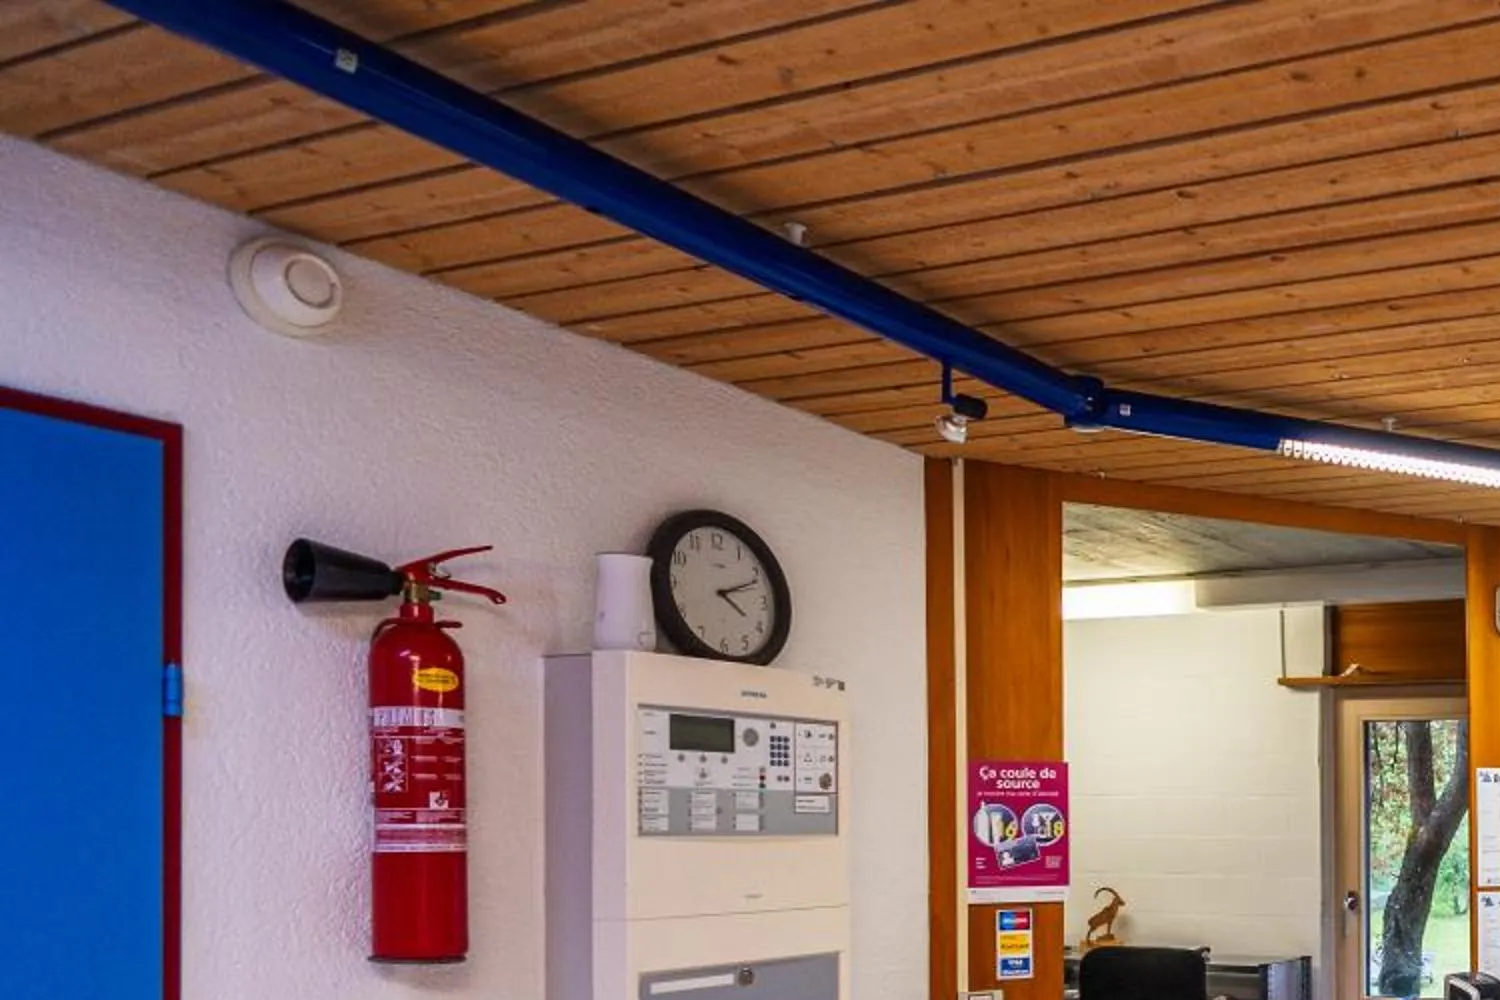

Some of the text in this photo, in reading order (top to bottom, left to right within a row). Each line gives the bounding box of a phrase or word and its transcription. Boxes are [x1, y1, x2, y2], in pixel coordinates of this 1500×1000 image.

[689, 533, 701, 550] 11
[711, 533, 723, 550] 12
[673, 551, 687, 568] 10
[720, 638, 729, 653] 6
[741, 635, 749, 651] 5
[979, 766, 997, 780] Ça
[1000, 767, 1036, 779] coule
[996, 780, 1040, 789] source
